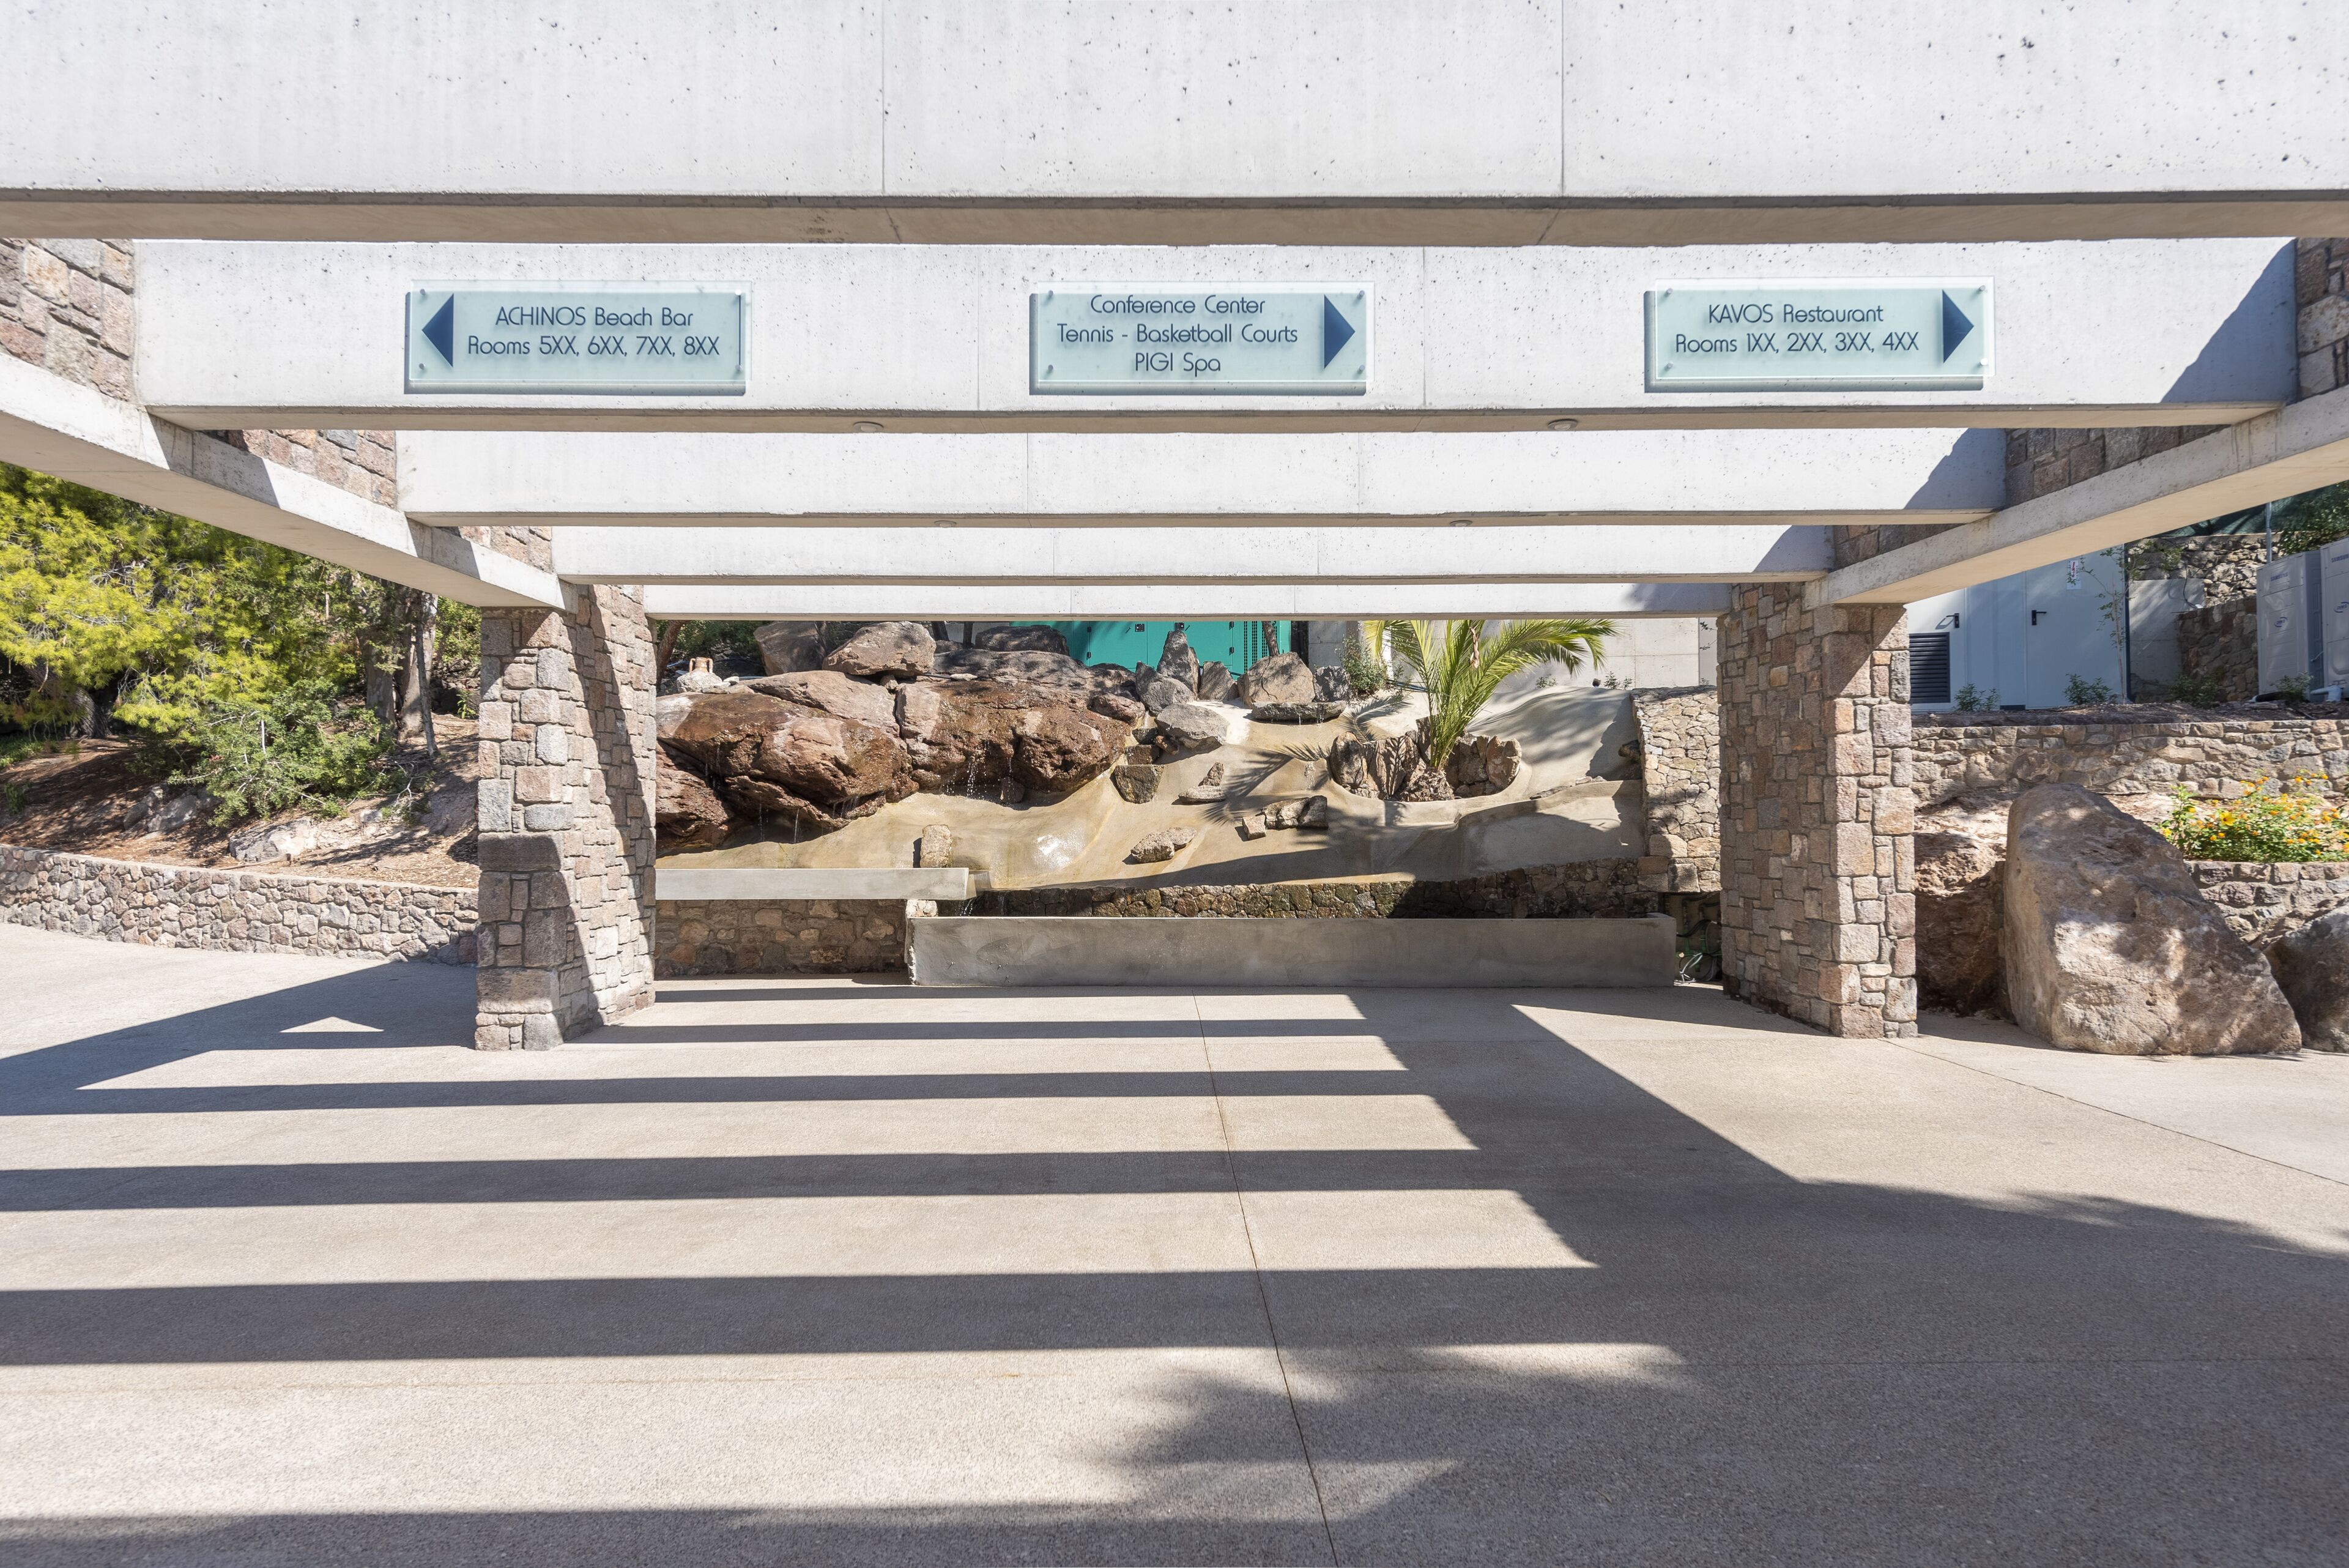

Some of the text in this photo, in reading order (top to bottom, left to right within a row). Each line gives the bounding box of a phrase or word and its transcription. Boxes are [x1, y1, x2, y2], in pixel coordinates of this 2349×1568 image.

[1090, 294, 1266, 314] Conference Center
[1709, 303, 1883, 324] KAVOS Restaurant
[495, 306, 694, 326] ACHINOS Beach Bar
[1056, 323, 1114, 343] Tennis
[1137, 323, 1232, 343] Basketball
[1241, 323, 1298, 343] Courts
[1675, 332, 1919, 354] Rooms 1XX, 2XX, 3XX, 4XX
[468, 335, 720, 357] Rooms 5XX, 6XX, 7XX, 8XX
[1135, 352, 1221, 377] PIGI Spa
